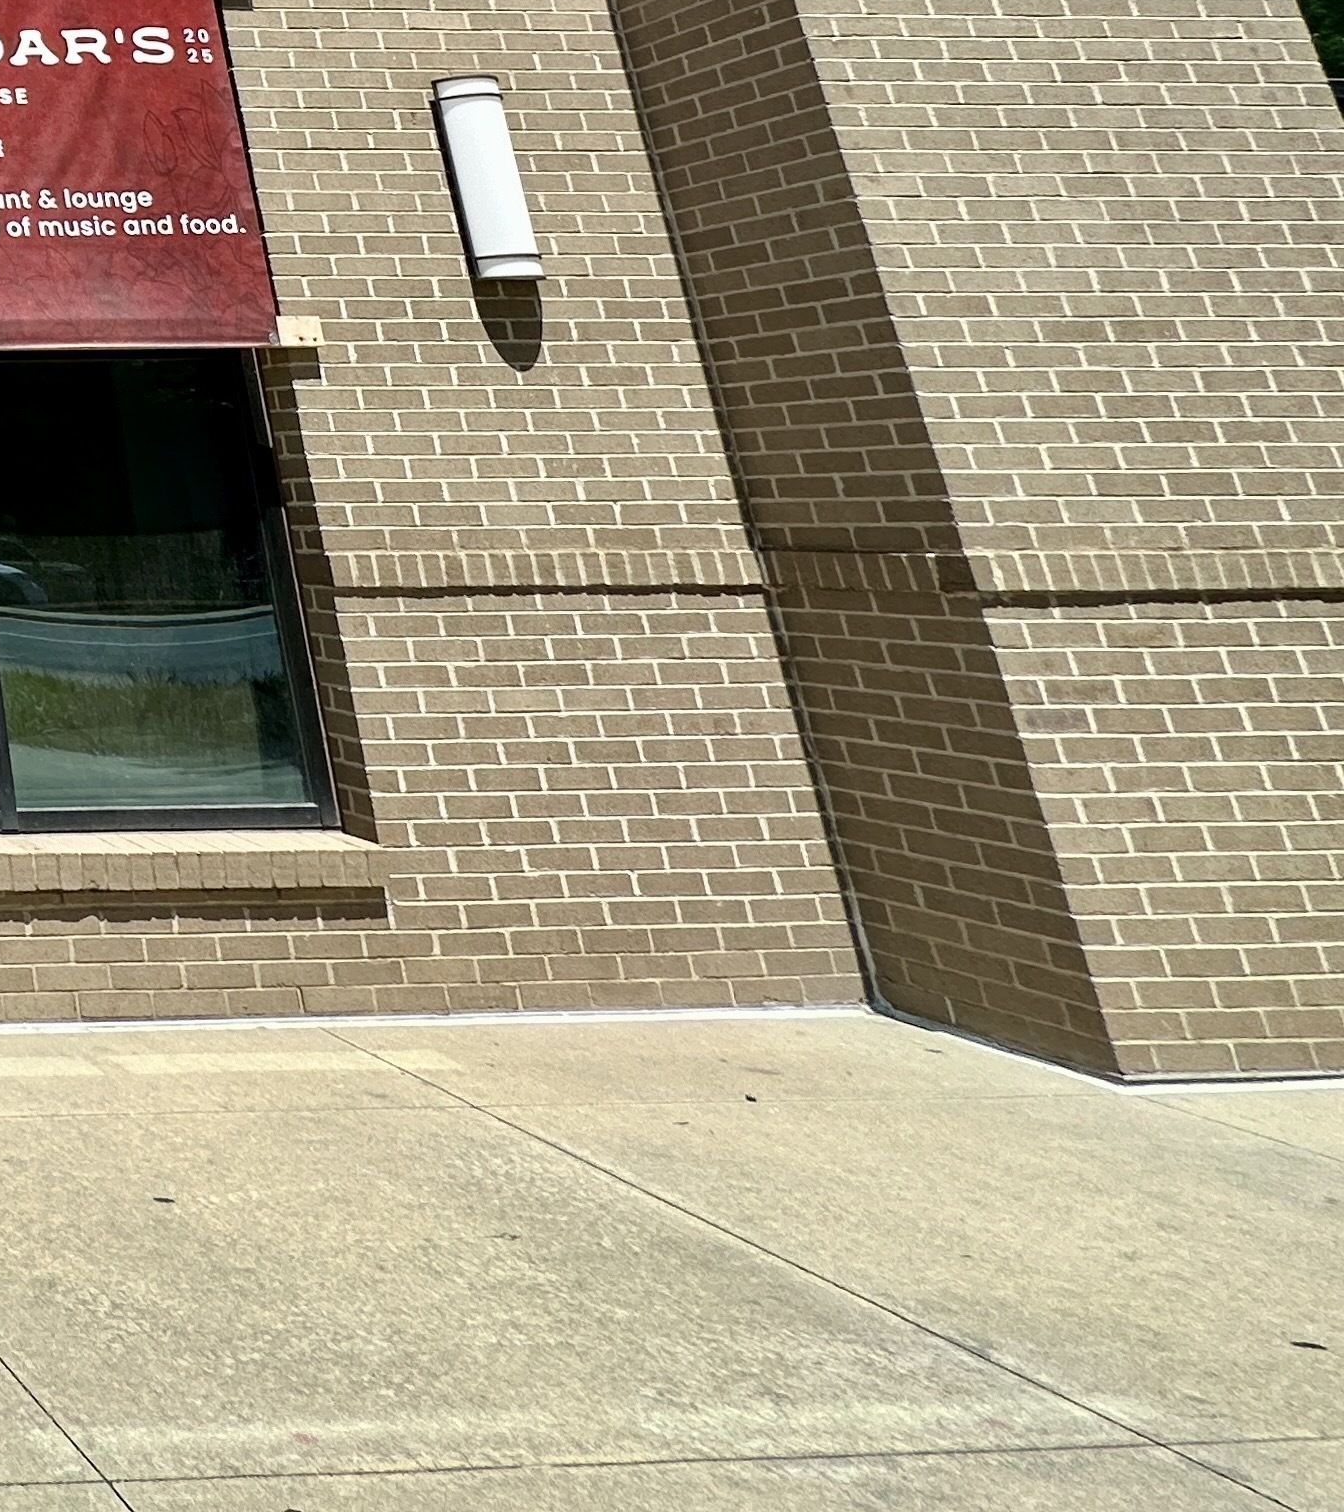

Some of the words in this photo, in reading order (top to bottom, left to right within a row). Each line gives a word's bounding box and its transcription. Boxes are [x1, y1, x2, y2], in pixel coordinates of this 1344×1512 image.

[183, 28, 209, 43] 20
[187, 47, 214, 63] 25
[38, 189, 58, 209] &
[63, 188, 153, 214] lounge
[6, 215, 31, 238] of
[38, 215, 116, 237] music
[123, 214, 174, 236] and
[179, 213, 247, 235] food.
